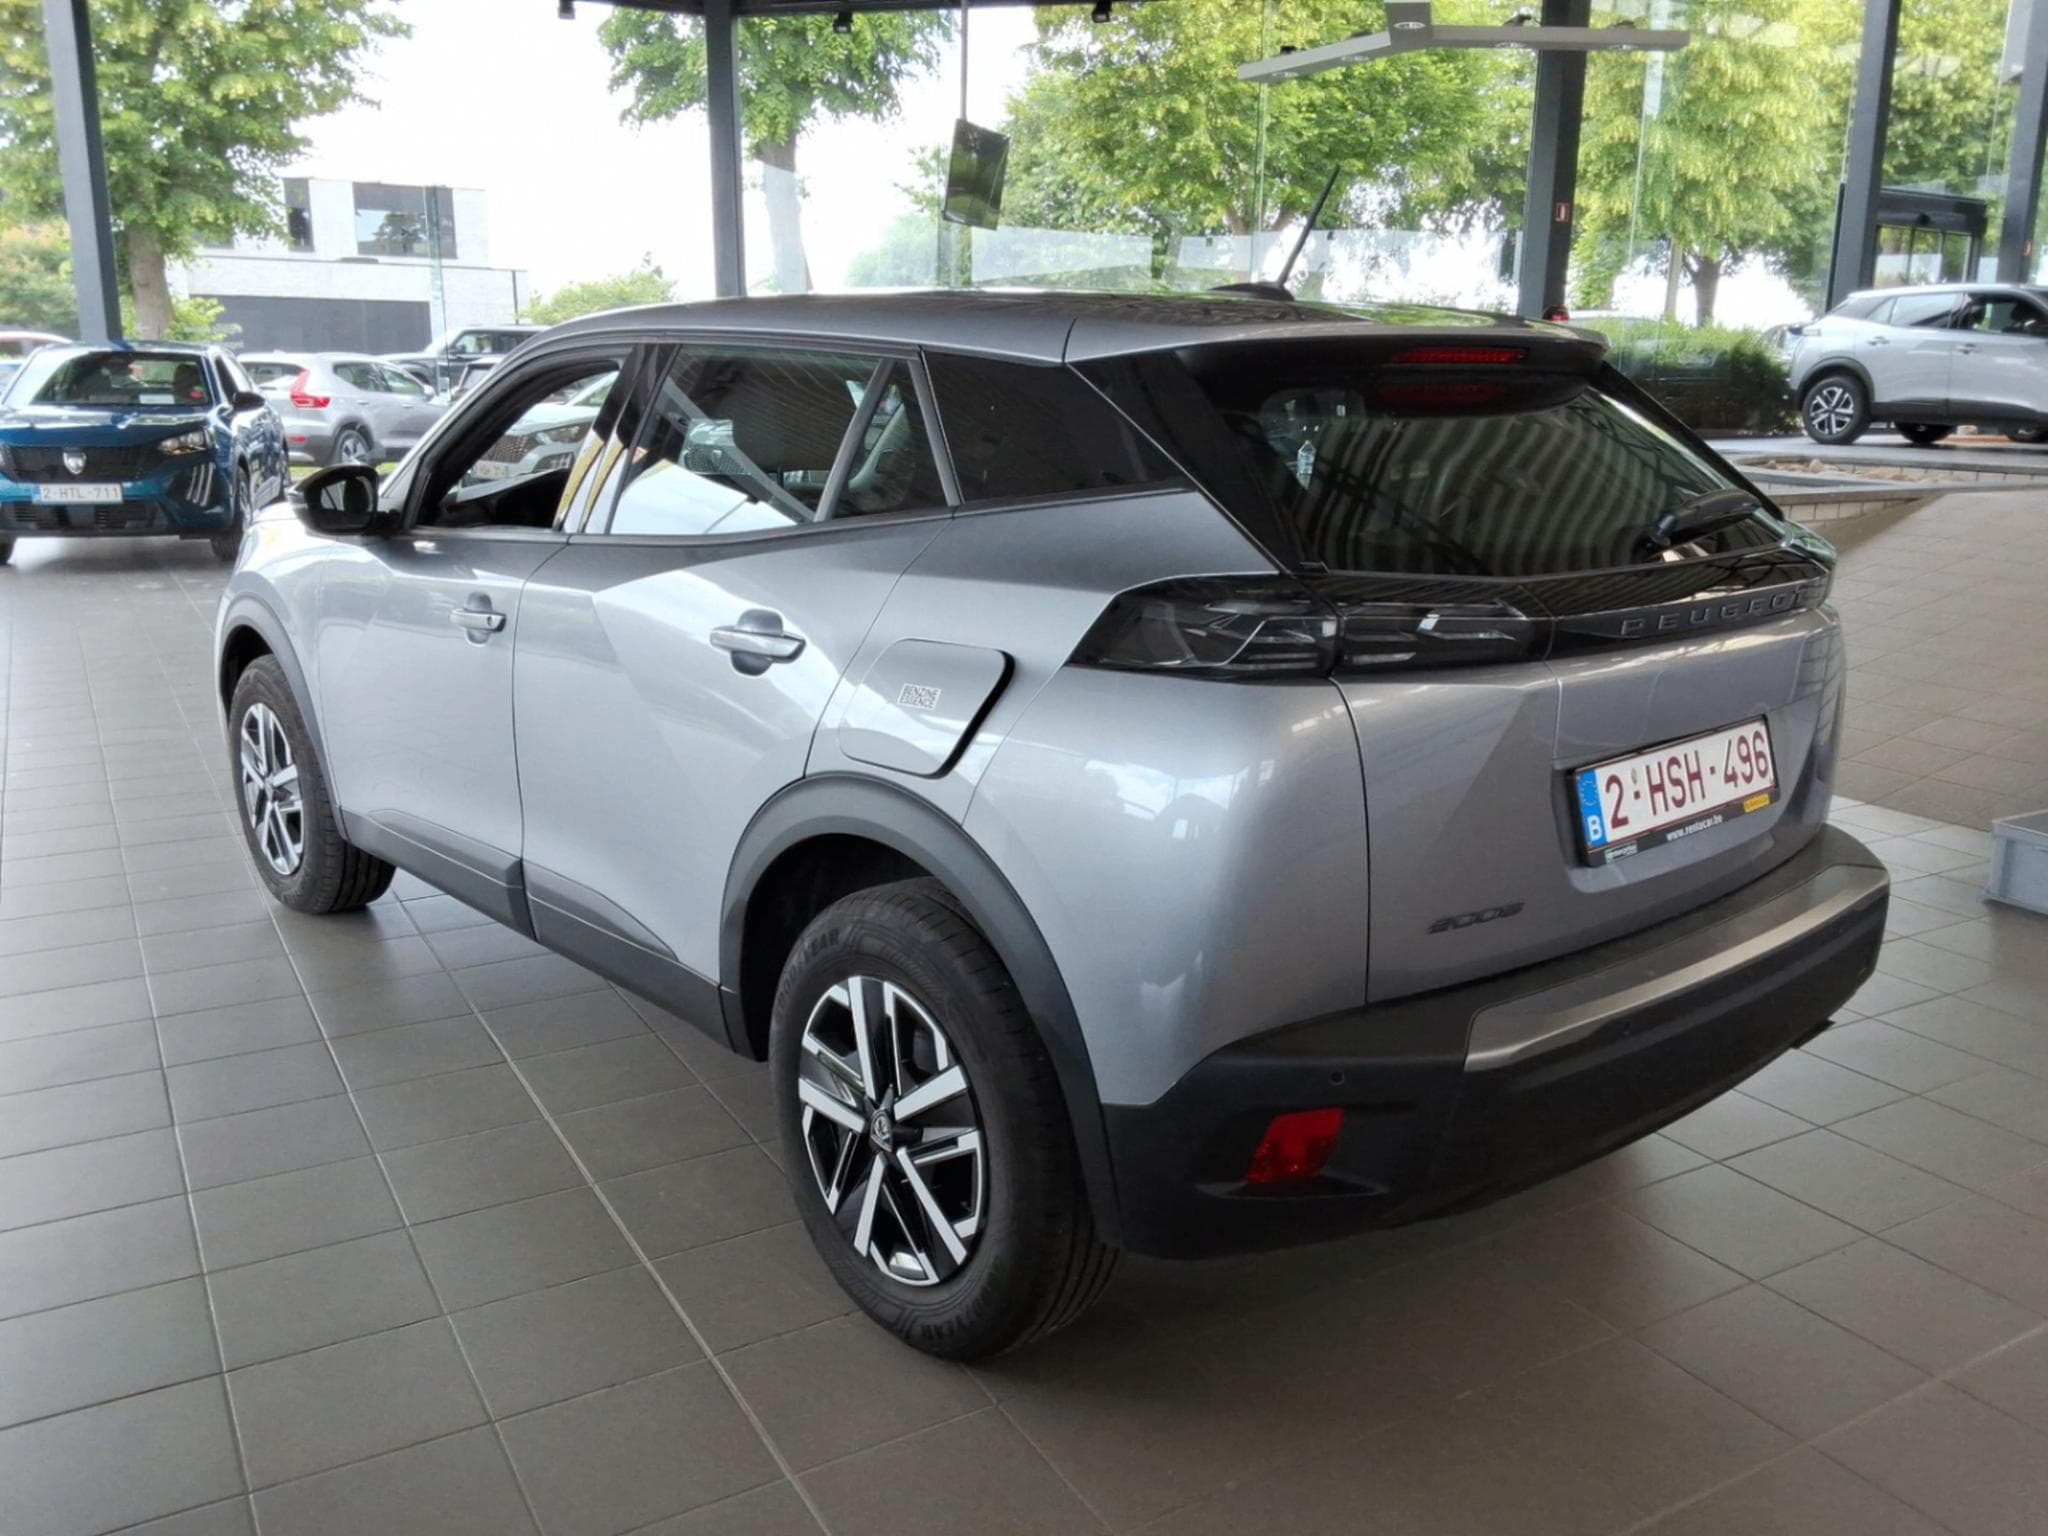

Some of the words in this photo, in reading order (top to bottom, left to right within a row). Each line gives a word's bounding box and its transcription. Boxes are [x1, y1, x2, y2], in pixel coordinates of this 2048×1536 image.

[1605, 730, 1769, 830] 2-HSH-496
[1587, 815, 1602, 841] B
[1426, 902, 1526, 935] 2008
